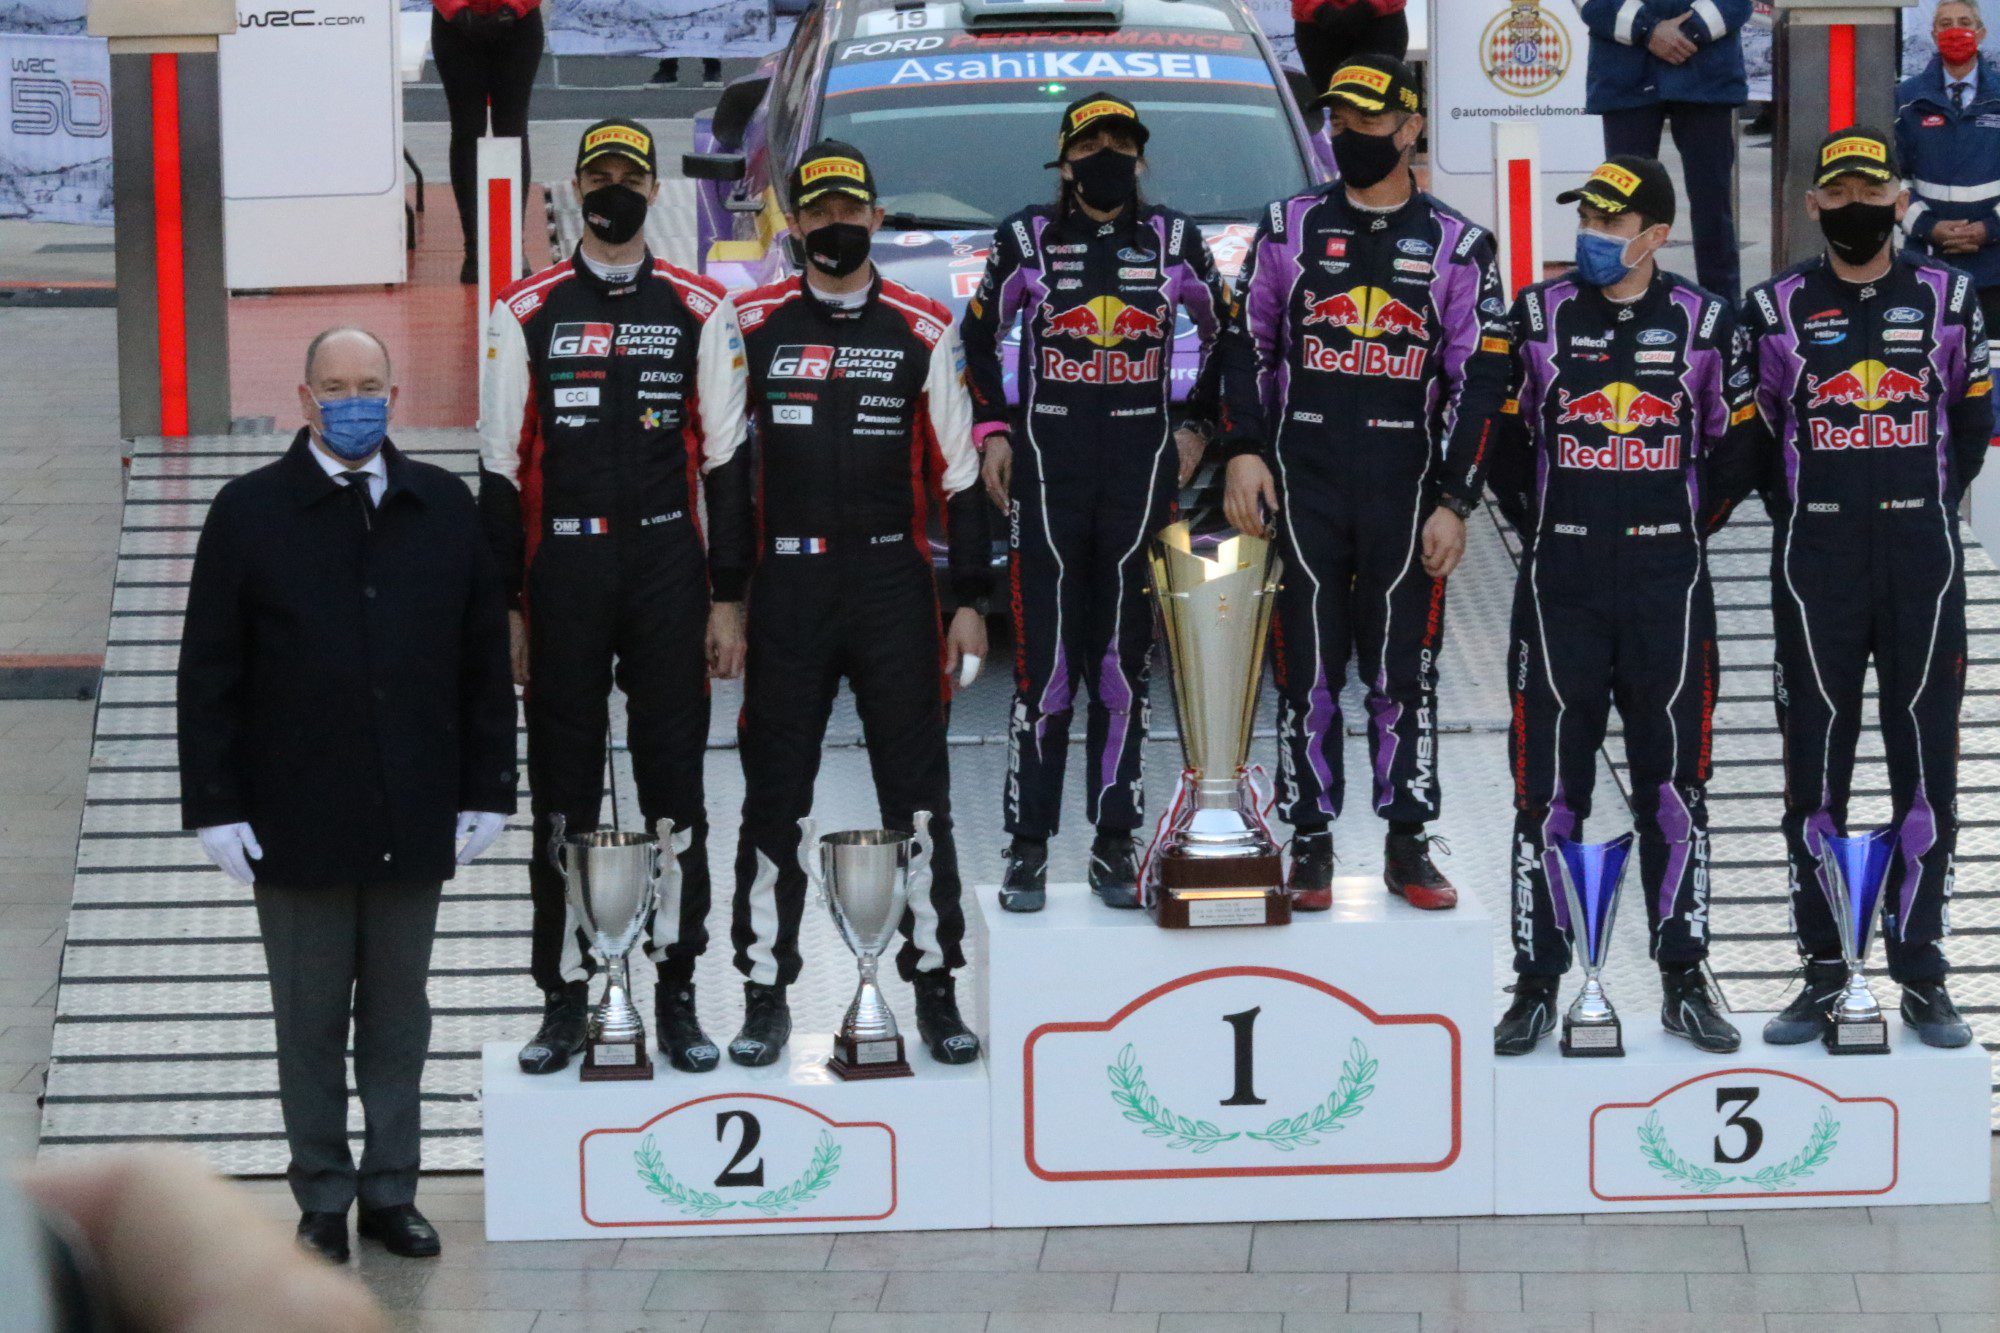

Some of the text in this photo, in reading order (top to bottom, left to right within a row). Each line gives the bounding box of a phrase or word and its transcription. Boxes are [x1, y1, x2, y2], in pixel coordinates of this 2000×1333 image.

[239, 10, 365, 27] WRC.com
[888, 11, 927, 29] 19
[840, 30, 1244, 60] FORD PERFORMANCE
[11, 58, 56, 74] WRC
[588, 131, 646, 151] PIRELLI
[1824, 139, 1882, 160] PIRELLI
[803, 160, 862, 179] PIRELLI
[1012, 221, 1034, 258] sparco
[1169, 219, 1185, 255] sparco
[513, 294, 541, 315] OMP
[686, 293, 712, 314] OMP
[1754, 289, 1778, 325] sparco
[618, 324, 682, 335] TOYOTA
[552, 336, 609, 355] GR
[616, 335, 677, 345] GAZOO
[1571, 336, 1607, 348] Keltech
[616, 346, 675, 359] Racing
[838, 347, 904, 359] TOYOTA
[1303, 335, 1428, 380] Red Bull
[771, 358, 828, 377] GR
[834, 359, 896, 370] GAZOO
[1042, 347, 1161, 384] Red Bull
[640, 371, 683, 383] DENSO
[832, 369, 894, 381] Racing
[637, 390, 682, 400] Panasonic
[860, 395, 905, 408] DENSO
[857, 412, 901, 423] Panasonic
[1808, 410, 1928, 450] Red Bull
[1558, 434, 1681, 471] Red Bull
[553, 521, 581, 532] OMP
[1010, 498, 1020, 549] FORD
[775, 541, 800, 551] OMP
[1517, 639, 1528, 690] FORD
[1221, 1006, 1266, 1106] 1
[1714, 1087, 1762, 1164] 3
[714, 1110, 764, 1187] 2
